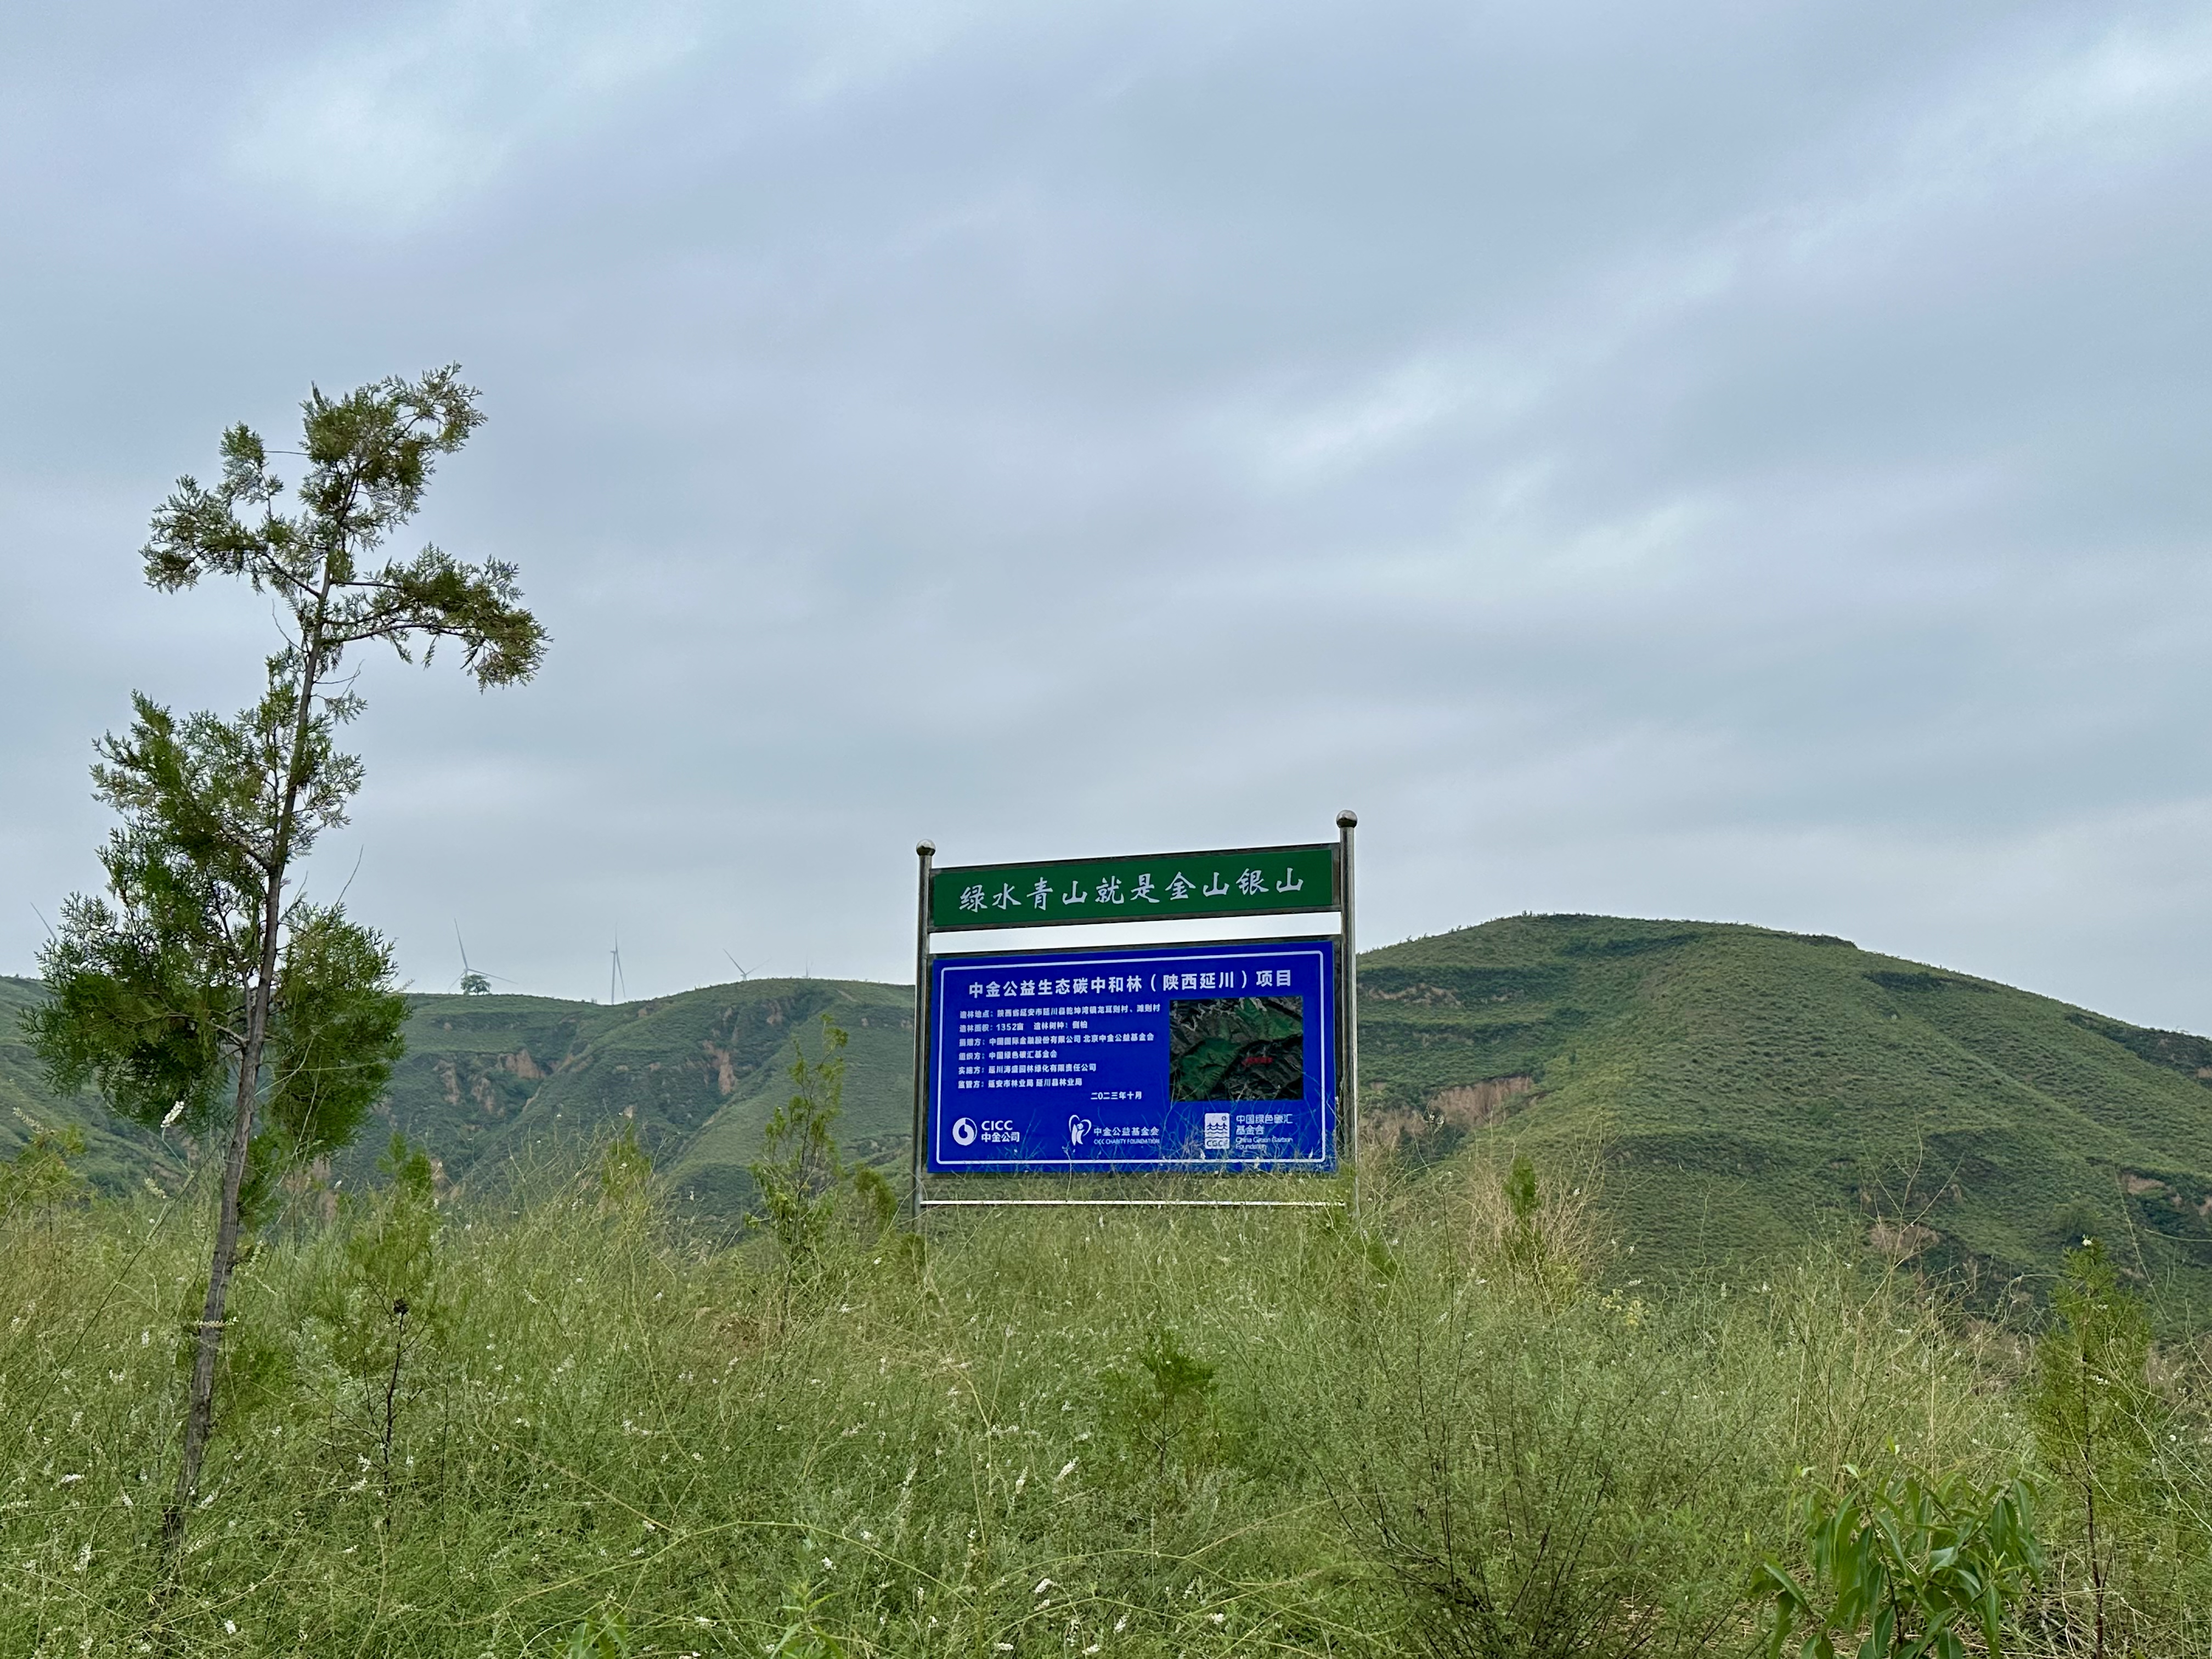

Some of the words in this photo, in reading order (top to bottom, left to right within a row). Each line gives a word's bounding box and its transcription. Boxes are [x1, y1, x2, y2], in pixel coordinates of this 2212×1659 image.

[960, 867, 1304, 913] 绿水青山就是金山银山
[969, 969, 1291, 998] 中金公益生态碳中和林（陕西延川）项目
[981, 1120, 1013, 1131] CICC
[1093, 1126, 1159, 1136] 中金公益基金会
[981, 1131, 1020, 1142] 中金公司
